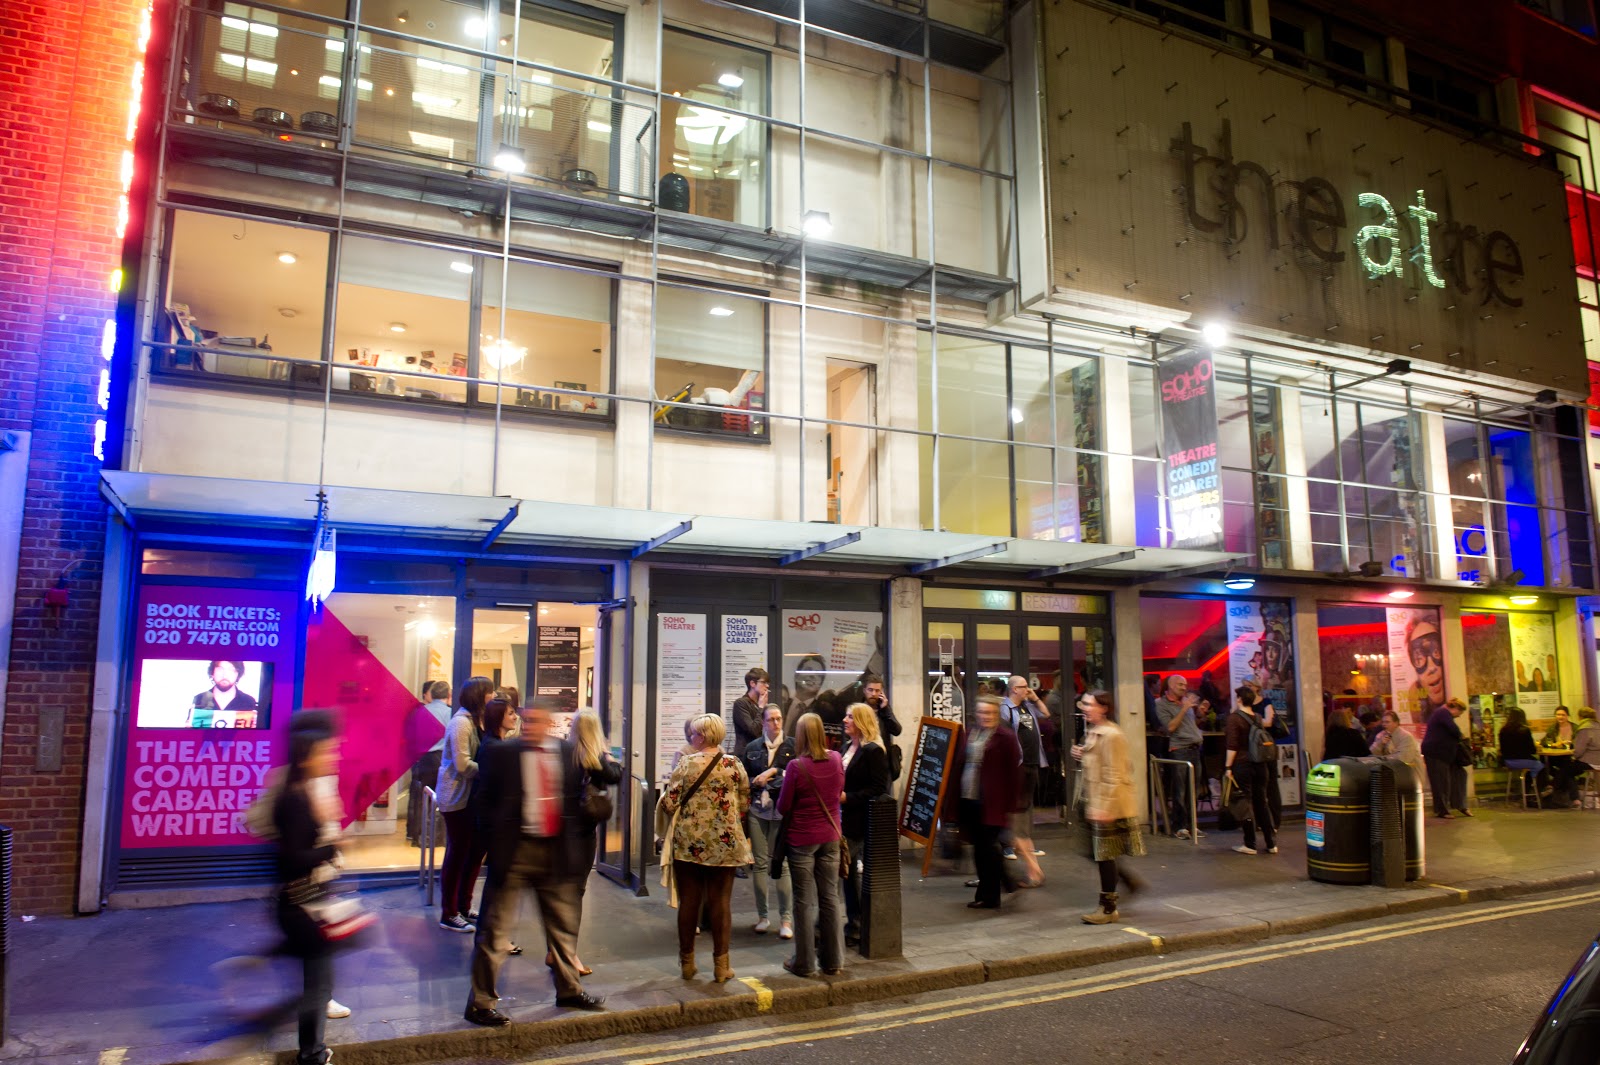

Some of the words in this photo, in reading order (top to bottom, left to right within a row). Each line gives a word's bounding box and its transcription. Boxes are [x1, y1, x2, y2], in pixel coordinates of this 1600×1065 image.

[1161, 359, 1213, 401] SOHO
[1168, 442, 1217, 468] THEATRE
[1169, 458, 1217, 483] COMEDY
[1170, 474, 1218, 497] CABARET
[147, 603, 201, 618] BOOK
[207, 605, 281, 621] TICKETS:
[1025, 594, 1107, 614] RESTAURA
[1229, 605, 1252, 617] SOHO
[145, 617, 280, 632] SOHOTHEATRE.COM
[663, 616, 686, 624] SOHO
[663, 623, 696, 631] THEATRE
[726, 617, 748, 625] SOHO
[788, 613, 821, 629] SOHO
[144, 630, 181, 644] 020
[187, 631, 231, 646] 7478
[237, 632, 279, 647] 0100
[726, 630, 757, 638] COMEDY
[942, 676, 952, 721] HEATRE
[952, 705, 962, 724] AR
[917, 725, 928, 756] SOHO
[135, 740, 271, 764] THEATRE
[133, 764, 272, 789] COMEDY
[131, 812, 253, 837] WRITER
